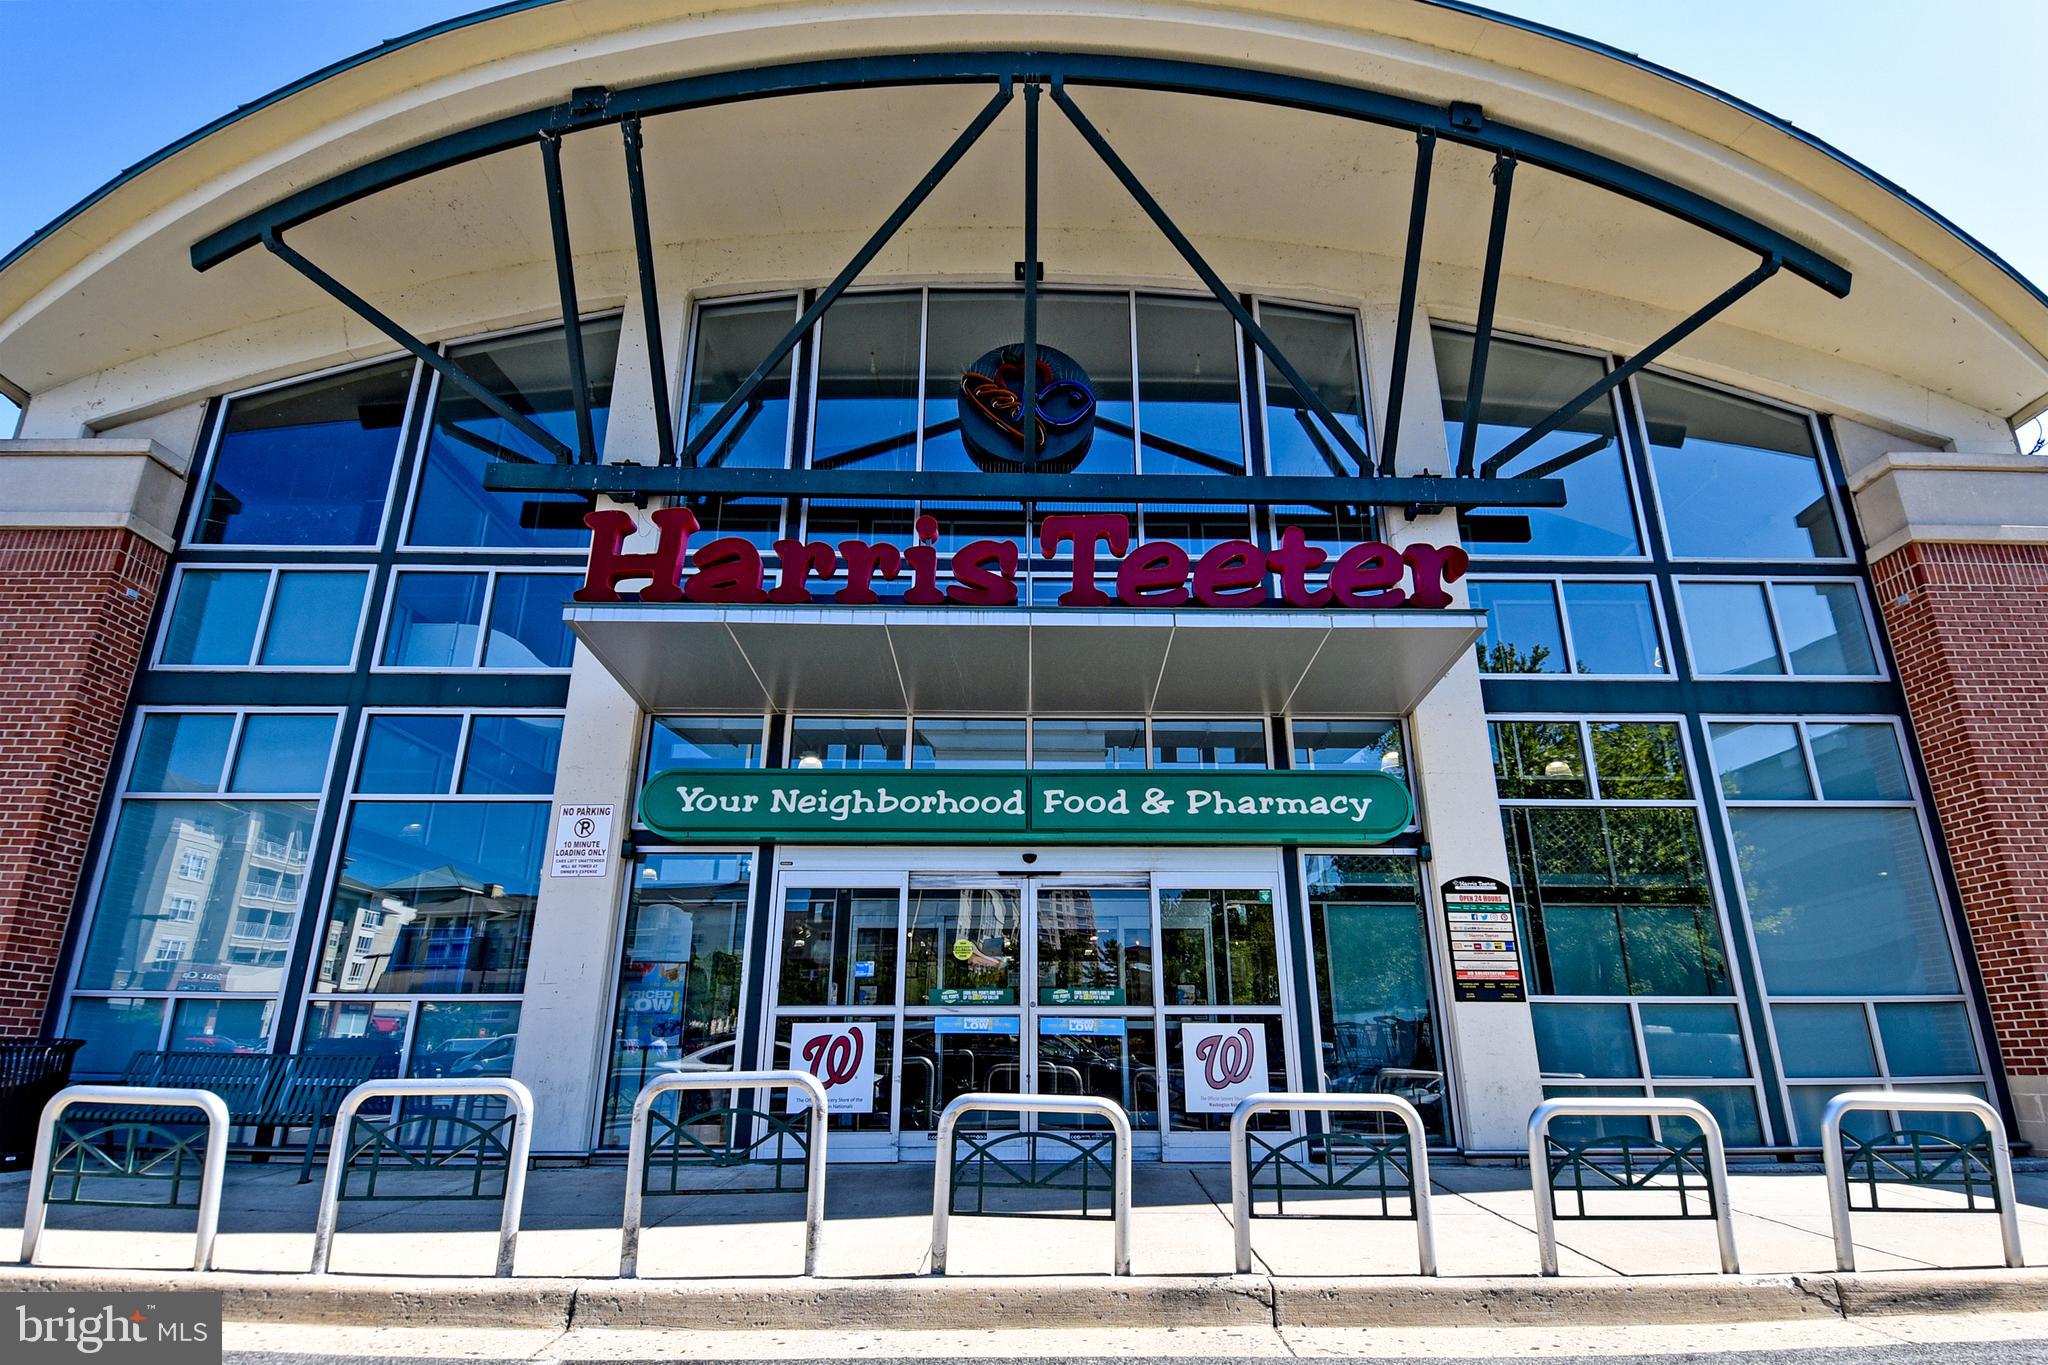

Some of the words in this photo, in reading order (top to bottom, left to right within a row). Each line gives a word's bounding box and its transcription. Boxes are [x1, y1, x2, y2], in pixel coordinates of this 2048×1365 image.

[573, 507, 1019, 604] Harris
[1040, 514, 1469, 607] Teeter
[562, 808, 574, 816] NO
[576, 807, 611, 816] PARKING
[676, 786, 758, 813] Your
[769, 788, 1025, 821] Neighborhood
[1043, 789, 1130, 815] Food
[1141, 787, 1174, 814] &
[1186, 789, 1373, 823] Pharmacy
[555, 849, 586, 857] LOADING
[587, 849, 606, 857] ONLY
[1196, 1027, 1254, 1090] W
